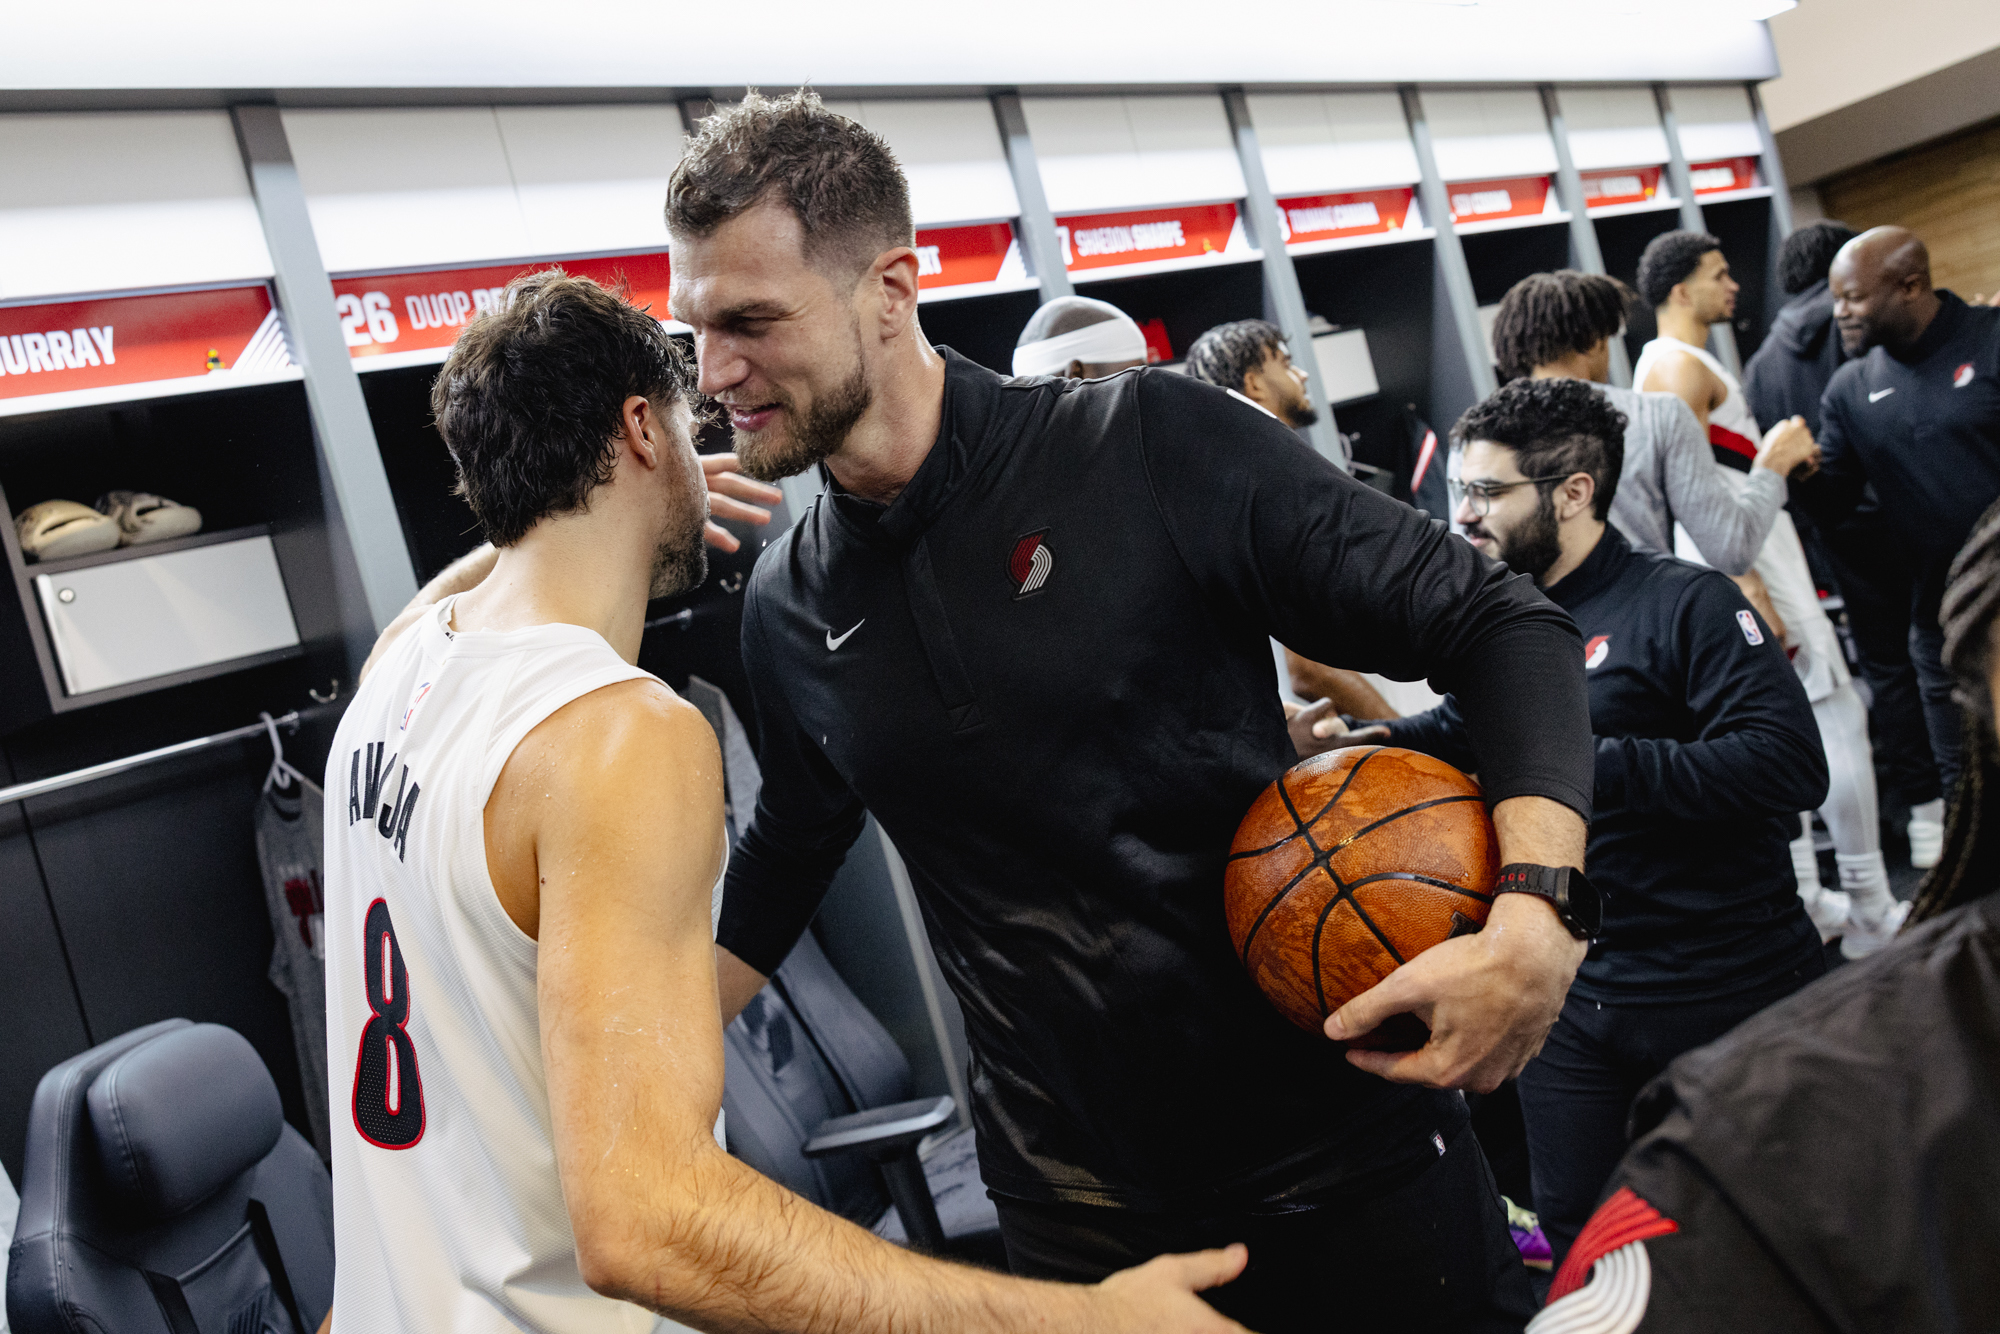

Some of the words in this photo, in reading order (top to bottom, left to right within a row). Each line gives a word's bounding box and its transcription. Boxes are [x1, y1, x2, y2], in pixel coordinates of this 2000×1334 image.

[336, 291, 399, 347] 26
[405, 291, 471, 330] DUOP
[351, 897, 426, 1151] 8
